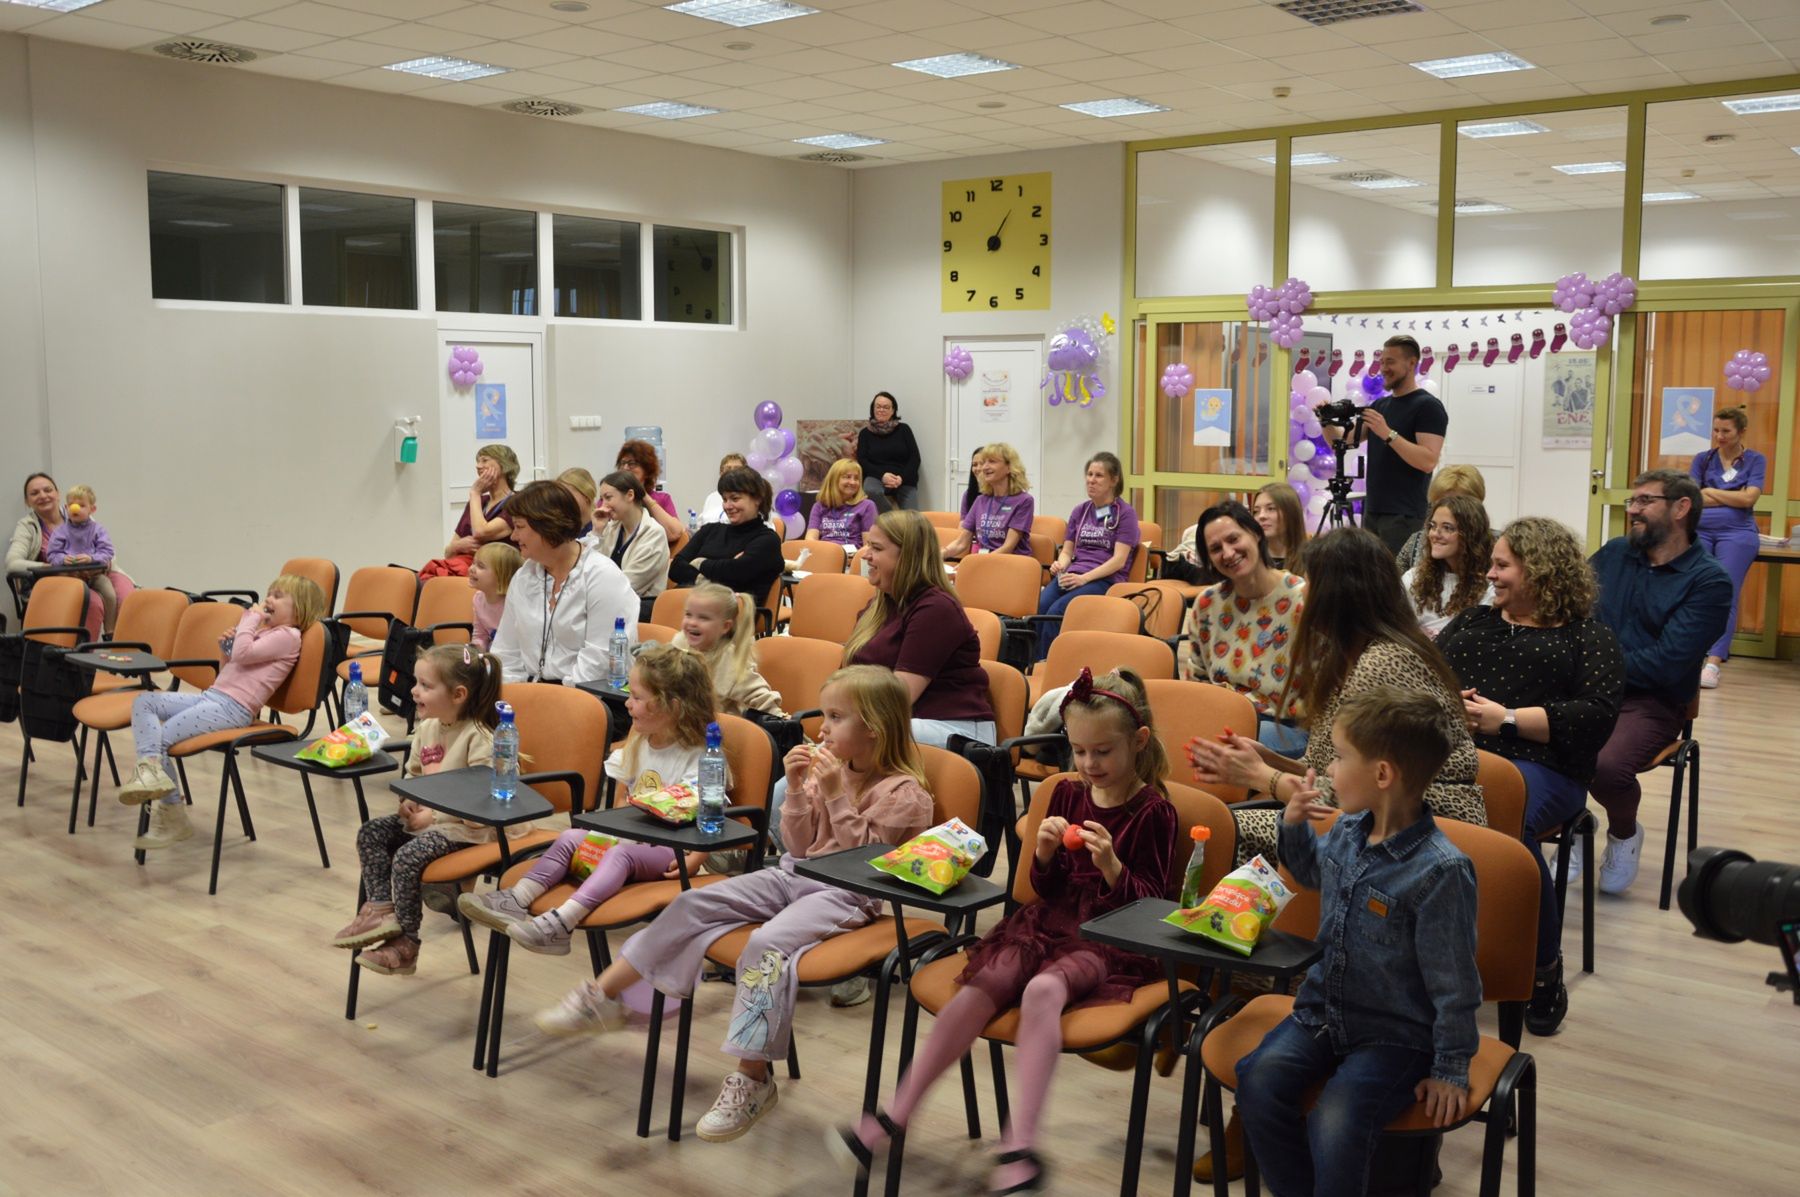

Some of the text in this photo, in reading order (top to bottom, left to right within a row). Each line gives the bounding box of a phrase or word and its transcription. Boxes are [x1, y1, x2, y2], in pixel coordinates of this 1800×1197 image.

[990, 180, 1003, 192] 12
[1018, 186, 1023, 197] 1
[966, 191, 975, 202] 11
[949, 211, 962, 222] 10
[1032, 206, 1042, 217] 2
[1039, 234, 1048, 246] 3
[943, 240, 952, 252] 9
[950, 271, 958, 282] 8
[1032, 266, 1041, 277] 4
[966, 290, 976, 302] 7
[1015, 288, 1024, 300] 5
[989, 296, 998, 308] 6
